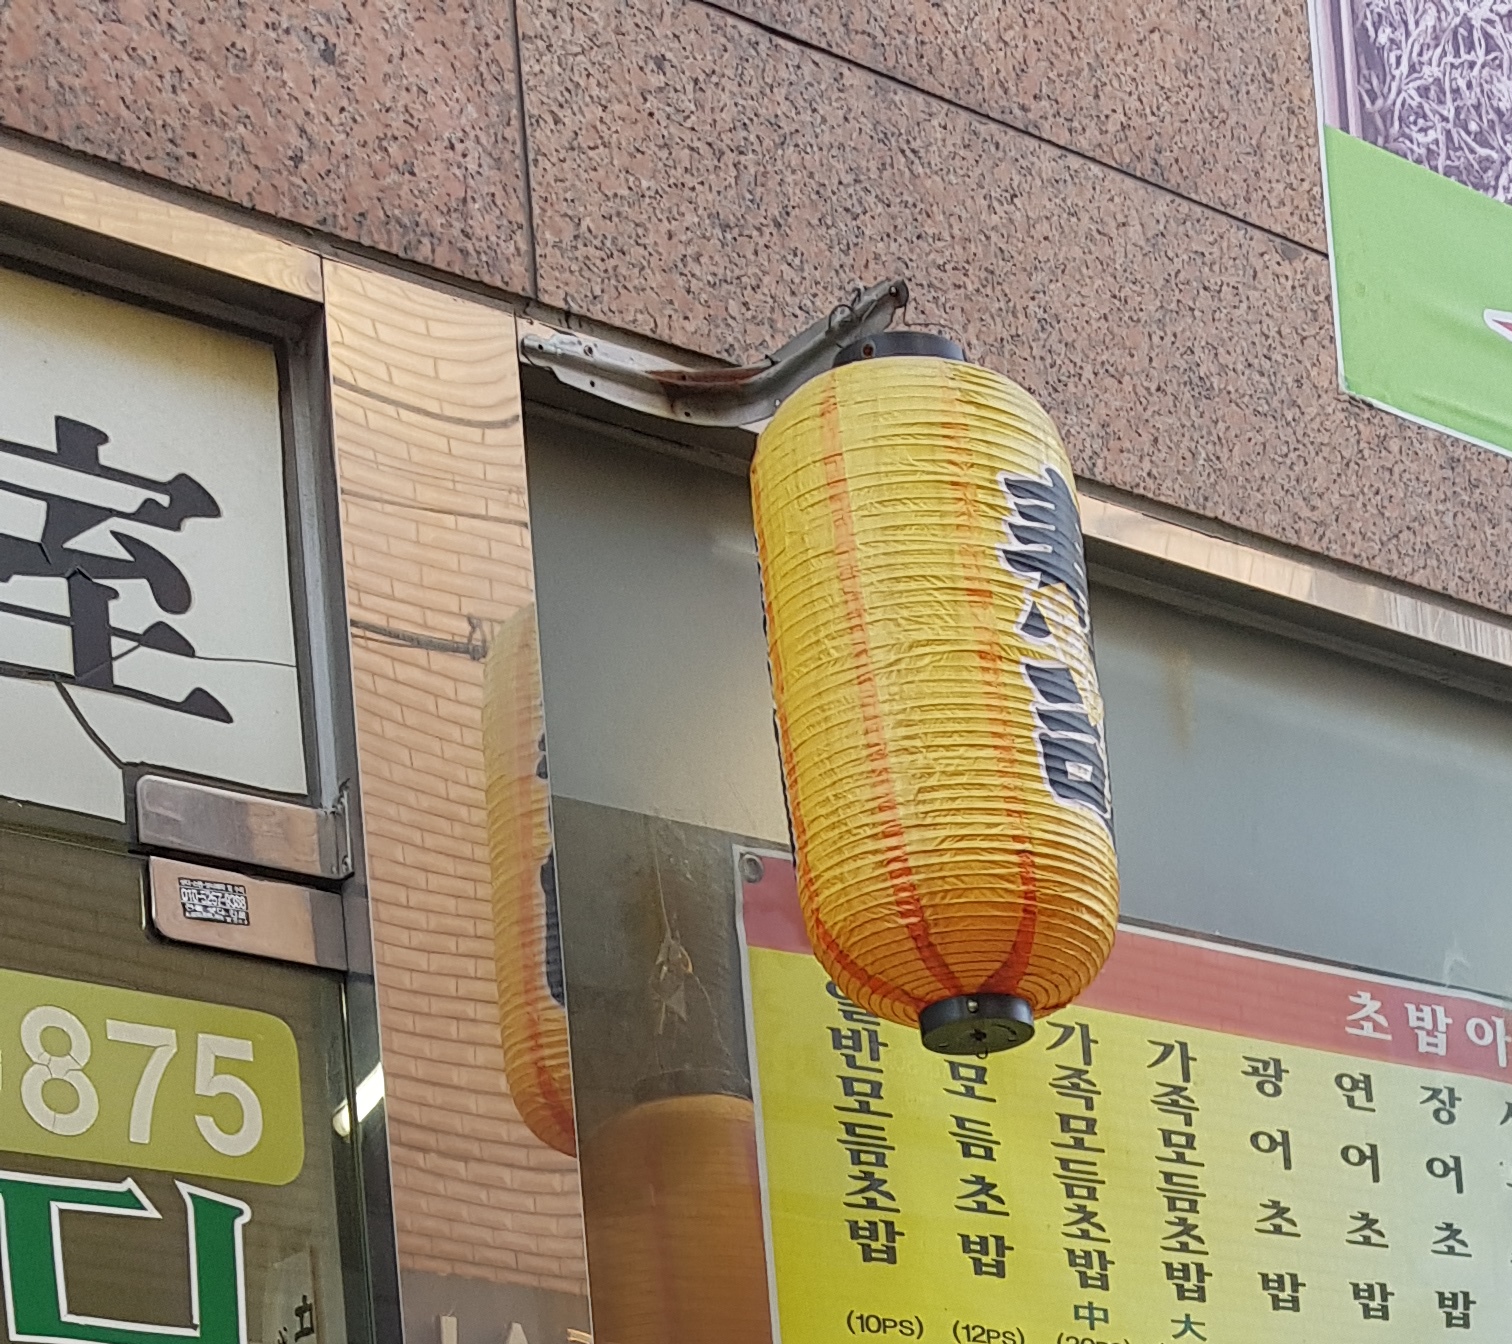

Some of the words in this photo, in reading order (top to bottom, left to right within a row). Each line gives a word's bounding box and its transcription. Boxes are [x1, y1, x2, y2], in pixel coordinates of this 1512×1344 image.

[1045, 1020, 1116, 1292] 가족모듬초밥
[1146, 1039, 1213, 1303] 가족모듬초밥
[1240, 1056, 1306, 1313] 광어초밥
[1334, 1071, 1395, 1321] 연어초밥
[1419, 1084, 1477, 1330] 장어초밥
[846, 1310, 925, 1340] (10PS)
[1073, 1300, 1110, 1331] 中
